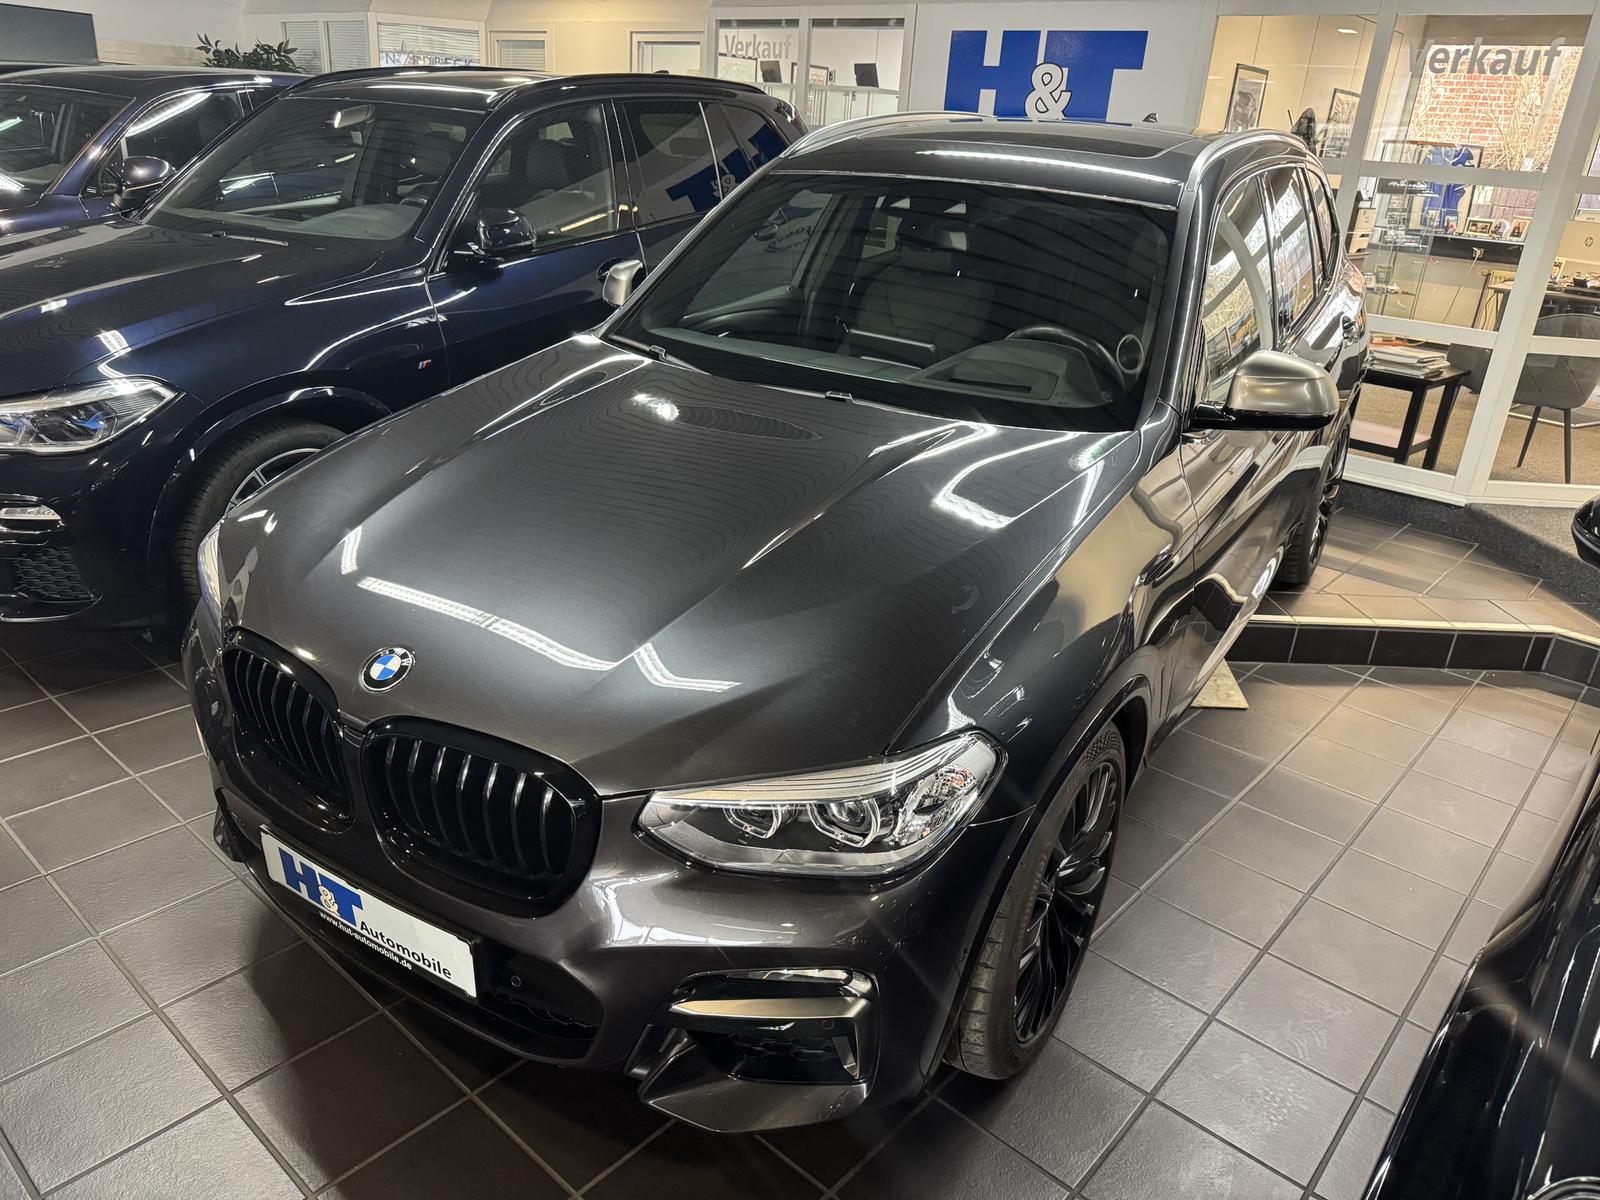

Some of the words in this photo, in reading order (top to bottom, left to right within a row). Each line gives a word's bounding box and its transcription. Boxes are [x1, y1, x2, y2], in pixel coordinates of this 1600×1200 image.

[725, 34, 792, 60] Verkauf
[944, 30, 1149, 121] H&T
[1409, 36, 1566, 77] Verkauf
[278, 847, 364, 927] H&T
[319, 910, 413, 970] www.hut-automobile.de
[360, 920, 452, 980] Automobile
